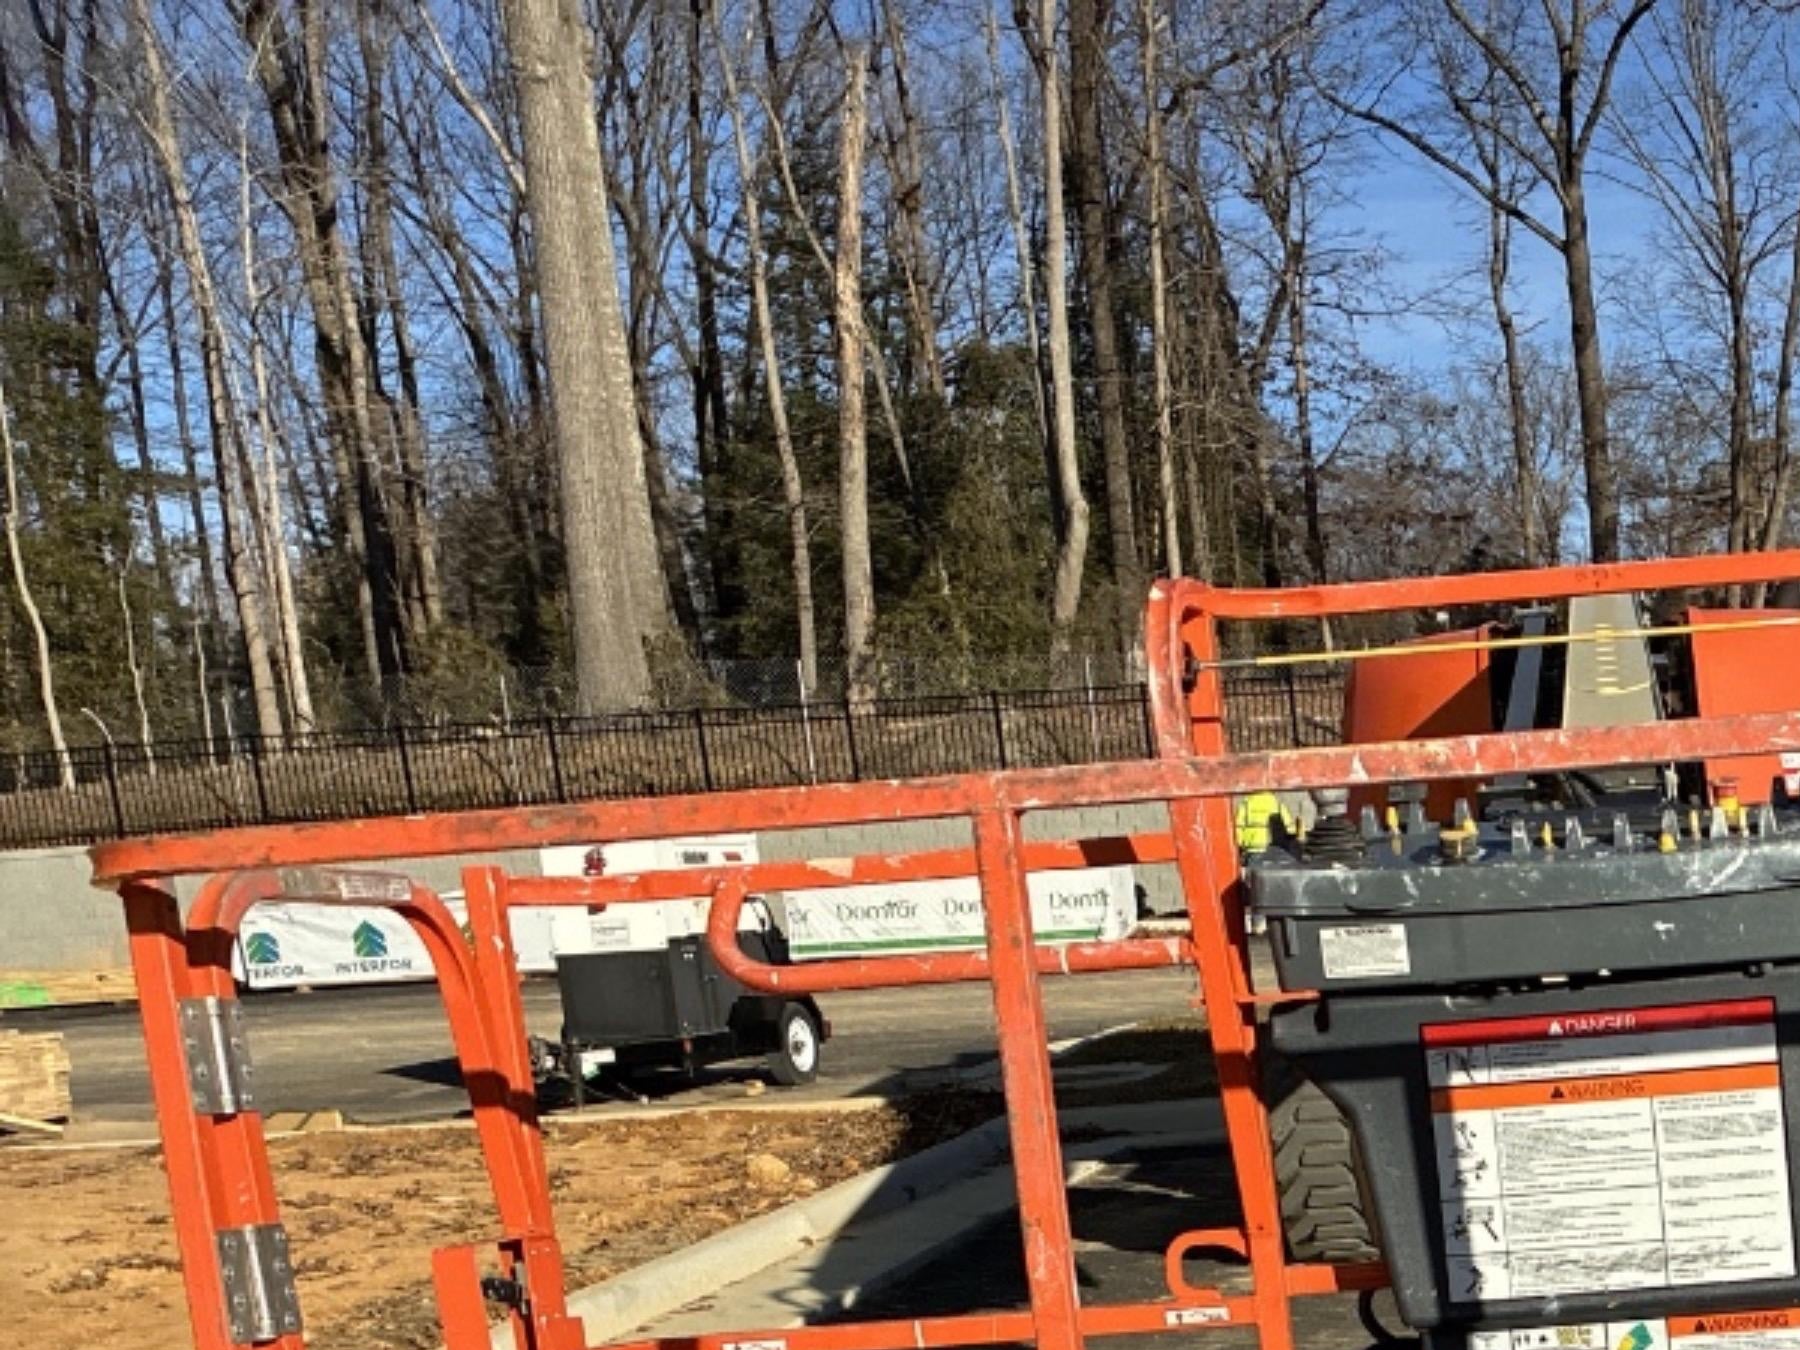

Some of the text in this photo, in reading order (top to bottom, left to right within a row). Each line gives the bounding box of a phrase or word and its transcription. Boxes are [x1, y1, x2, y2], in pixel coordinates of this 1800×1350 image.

[1049, 889, 1110, 911] Domt
[335, 957, 412, 974] INTERFOR
[1565, 1014, 1636, 1034] DANGER
[1566, 1079, 1646, 1099] WARNING
[1707, 1312, 1789, 1332] WARNING
